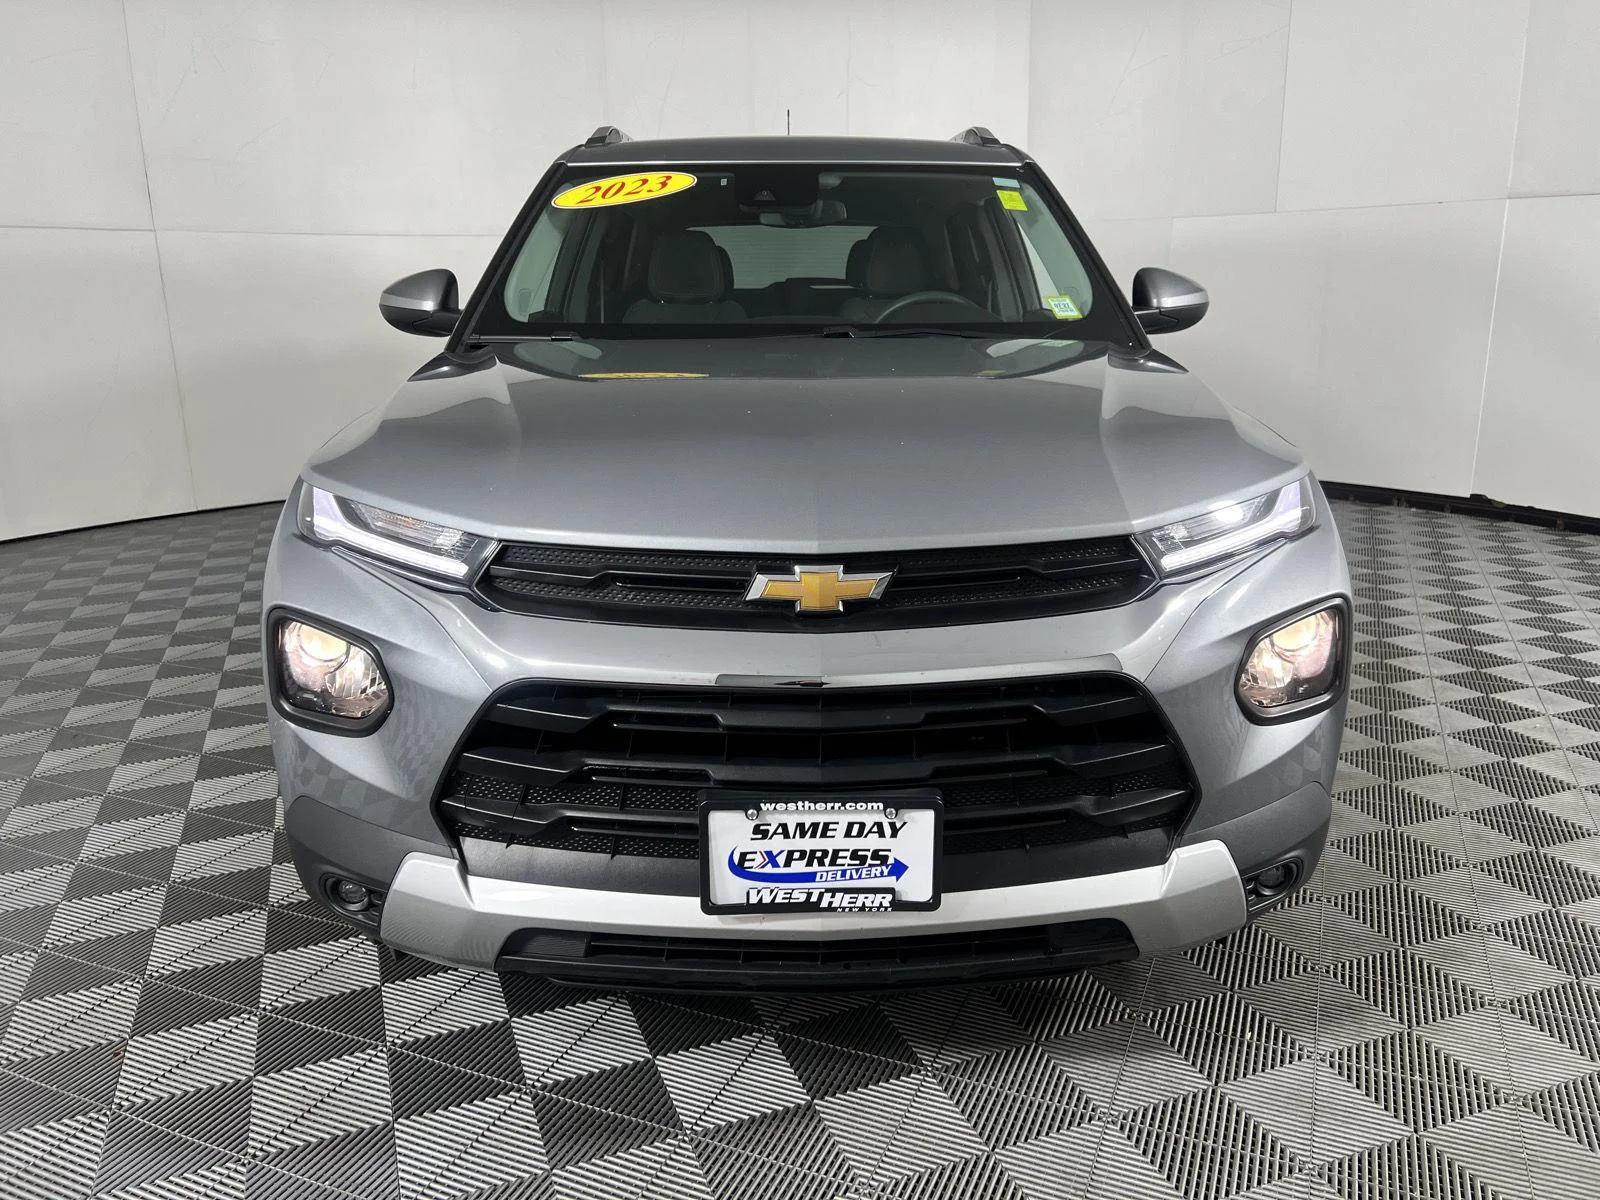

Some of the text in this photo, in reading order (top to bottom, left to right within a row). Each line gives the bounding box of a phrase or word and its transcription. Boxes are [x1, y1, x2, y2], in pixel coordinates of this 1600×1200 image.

[576, 175, 673, 205] 2023
[760, 800, 884, 811] westherr.com
[750, 820, 908, 841] SAME DAY
[737, 848, 892, 869] EXPRESS
[815, 864, 892, 882] DELIVERY
